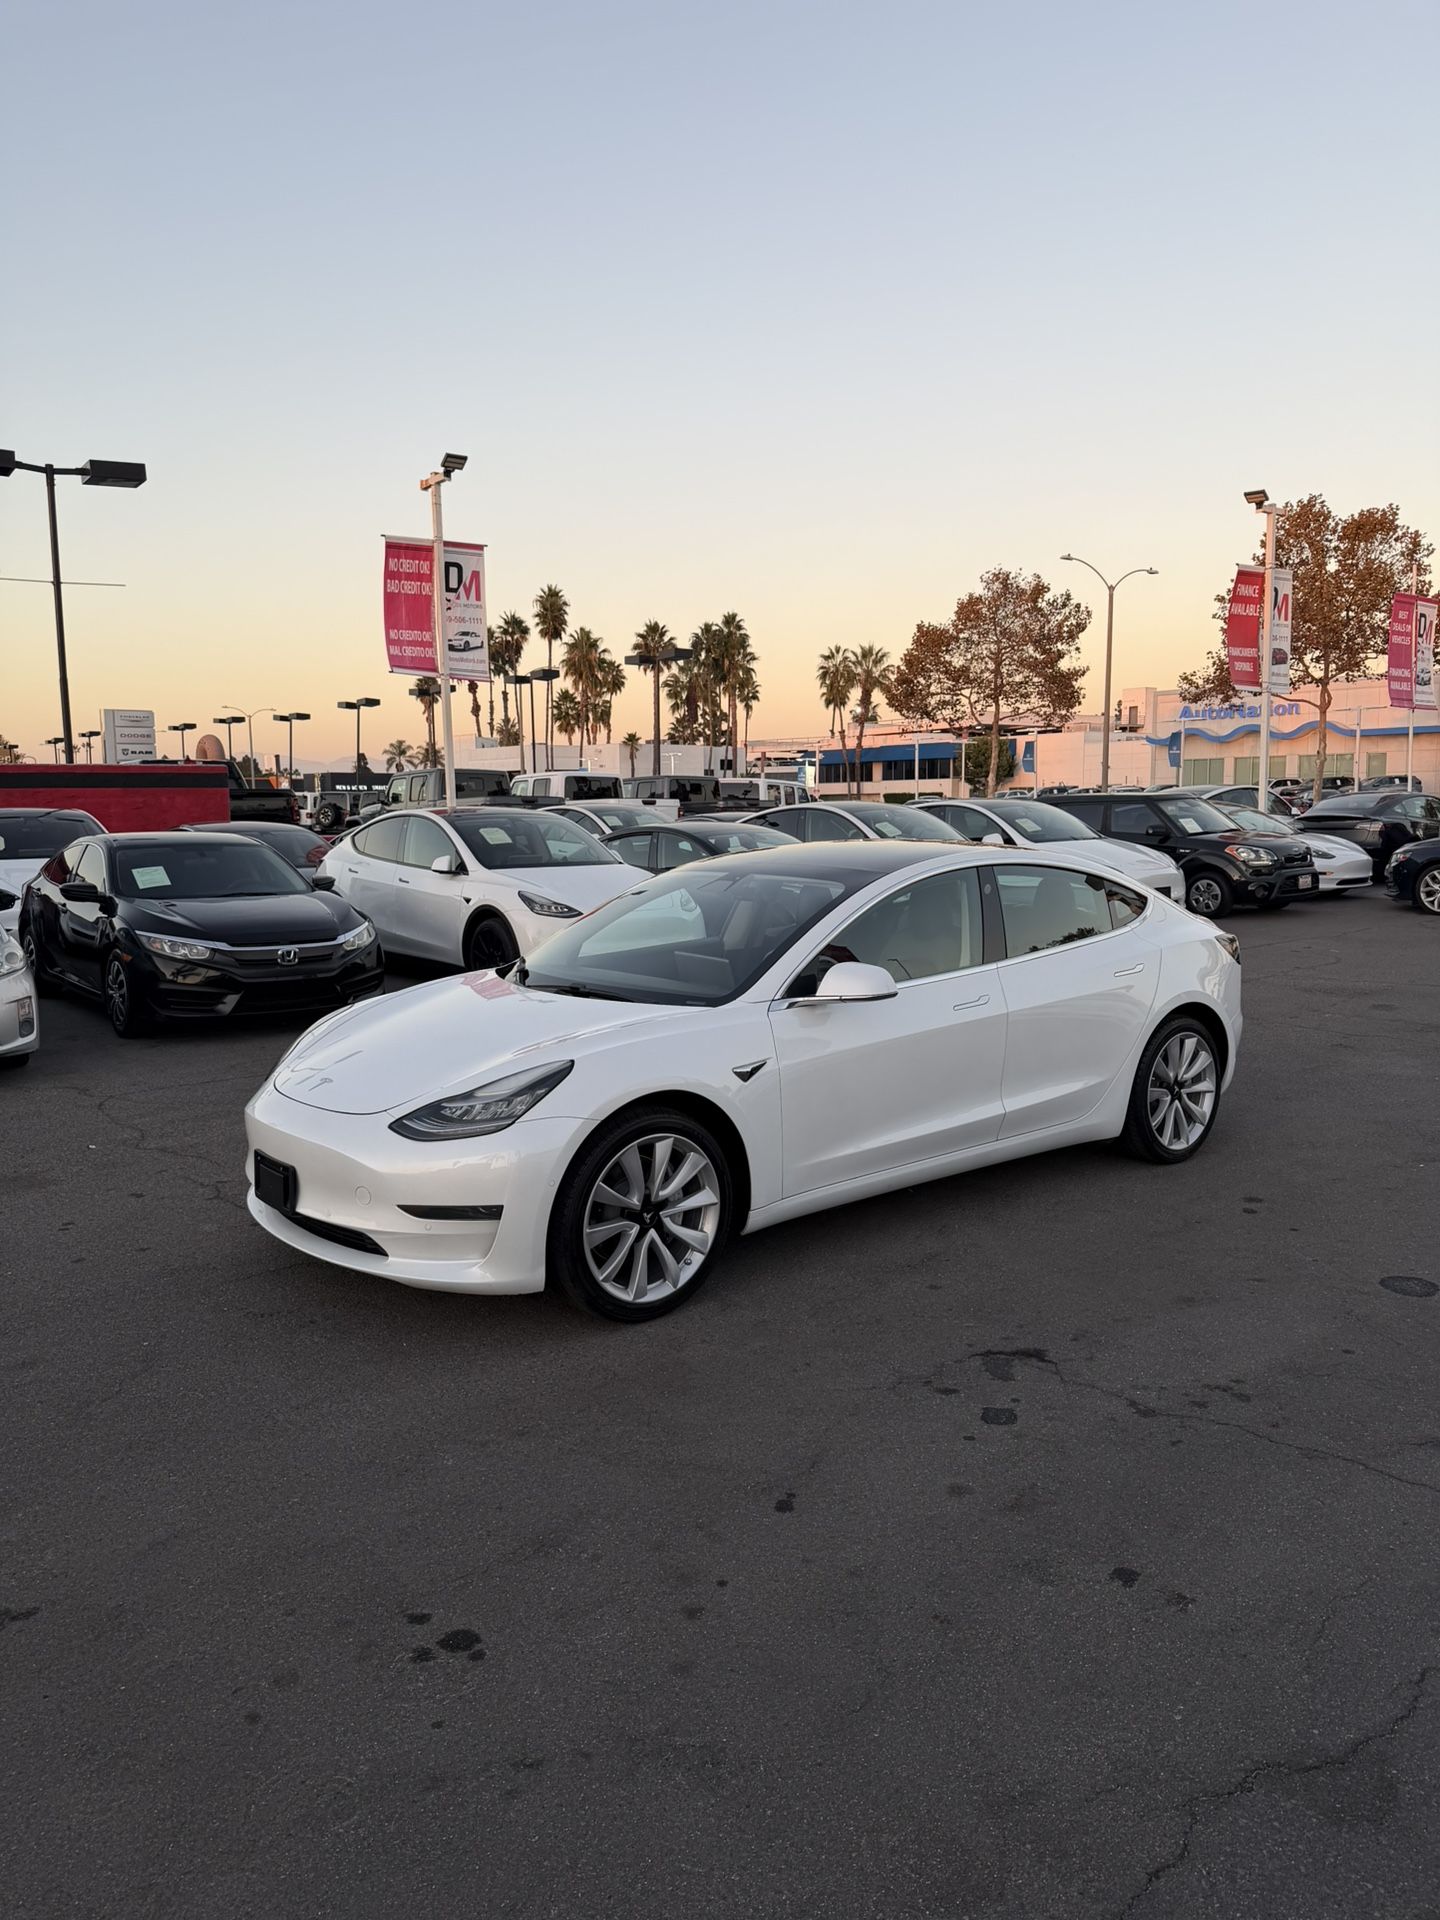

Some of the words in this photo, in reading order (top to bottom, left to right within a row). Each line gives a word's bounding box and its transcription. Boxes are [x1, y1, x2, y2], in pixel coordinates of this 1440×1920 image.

[389, 558, 398, 571] NO
[399, 559, 419, 573] CREDIT
[386, 579, 399, 593] BAD
[400, 580, 421, 594] CREDIT
[1236, 584, 1260, 597] FINANCE
[1230, 603, 1260, 616] AVAILABLE
[399, 630, 421, 641] CREDITO
[389, 645, 401, 656] MAL
[402, 646, 425, 657] CREDITO
